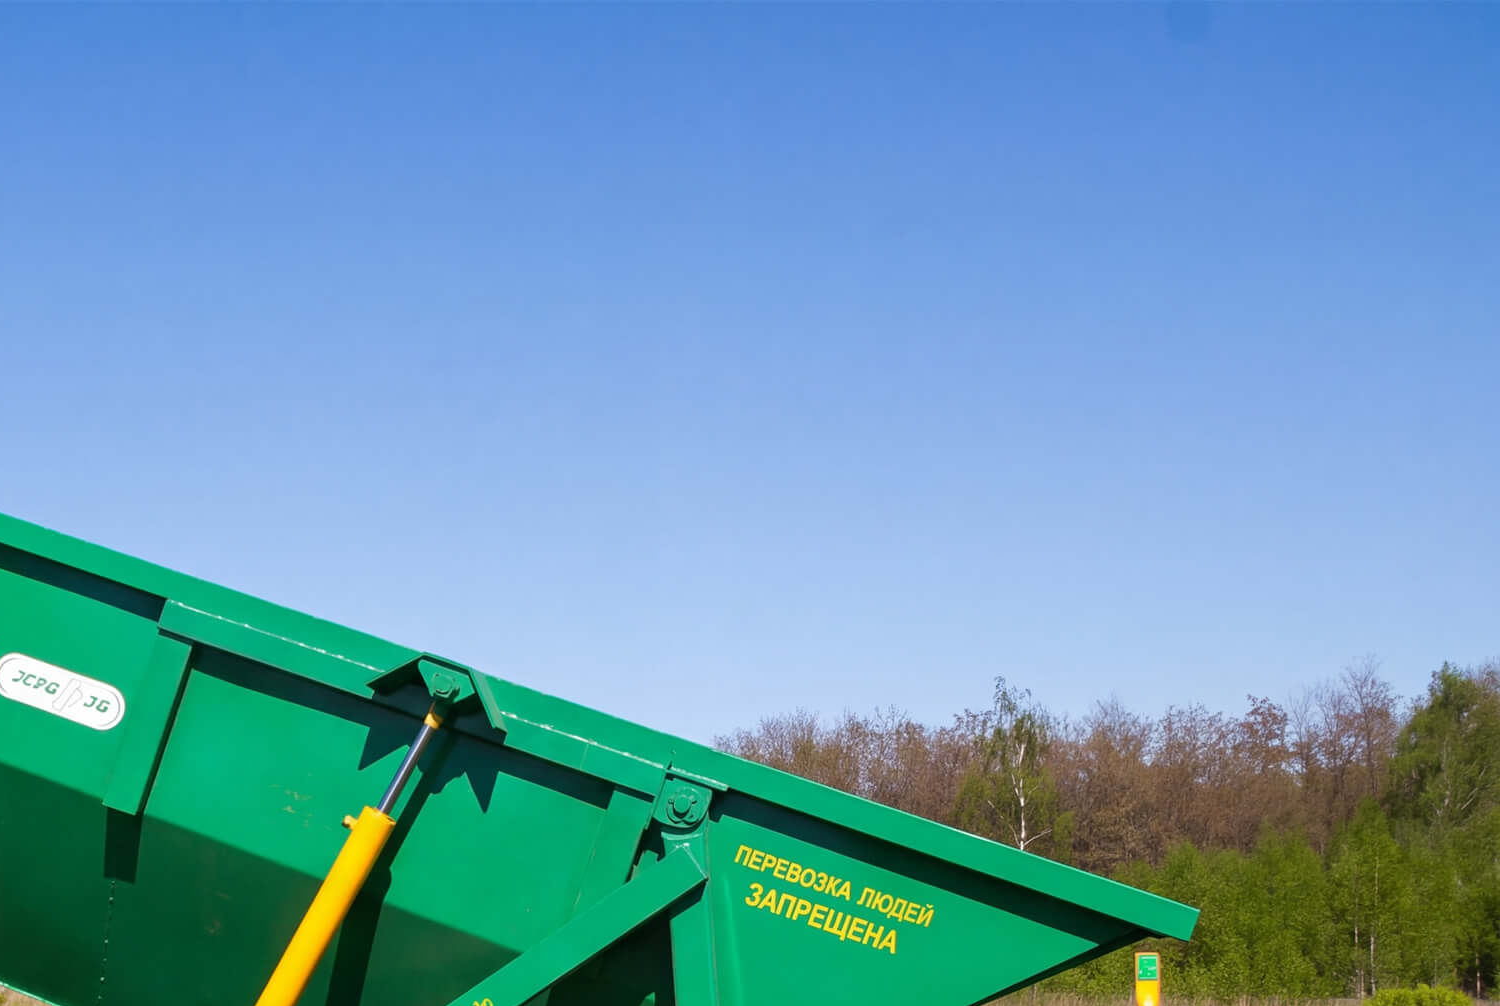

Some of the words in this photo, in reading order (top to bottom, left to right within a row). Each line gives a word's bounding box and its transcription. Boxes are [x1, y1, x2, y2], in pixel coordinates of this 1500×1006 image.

[734, 844, 851, 900] ПЕРЕВОЗКА
[856, 887, 935, 928] ЛЮДЕЙ
[744, 882, 897, 955] ЗАПРЕЩЕНА
